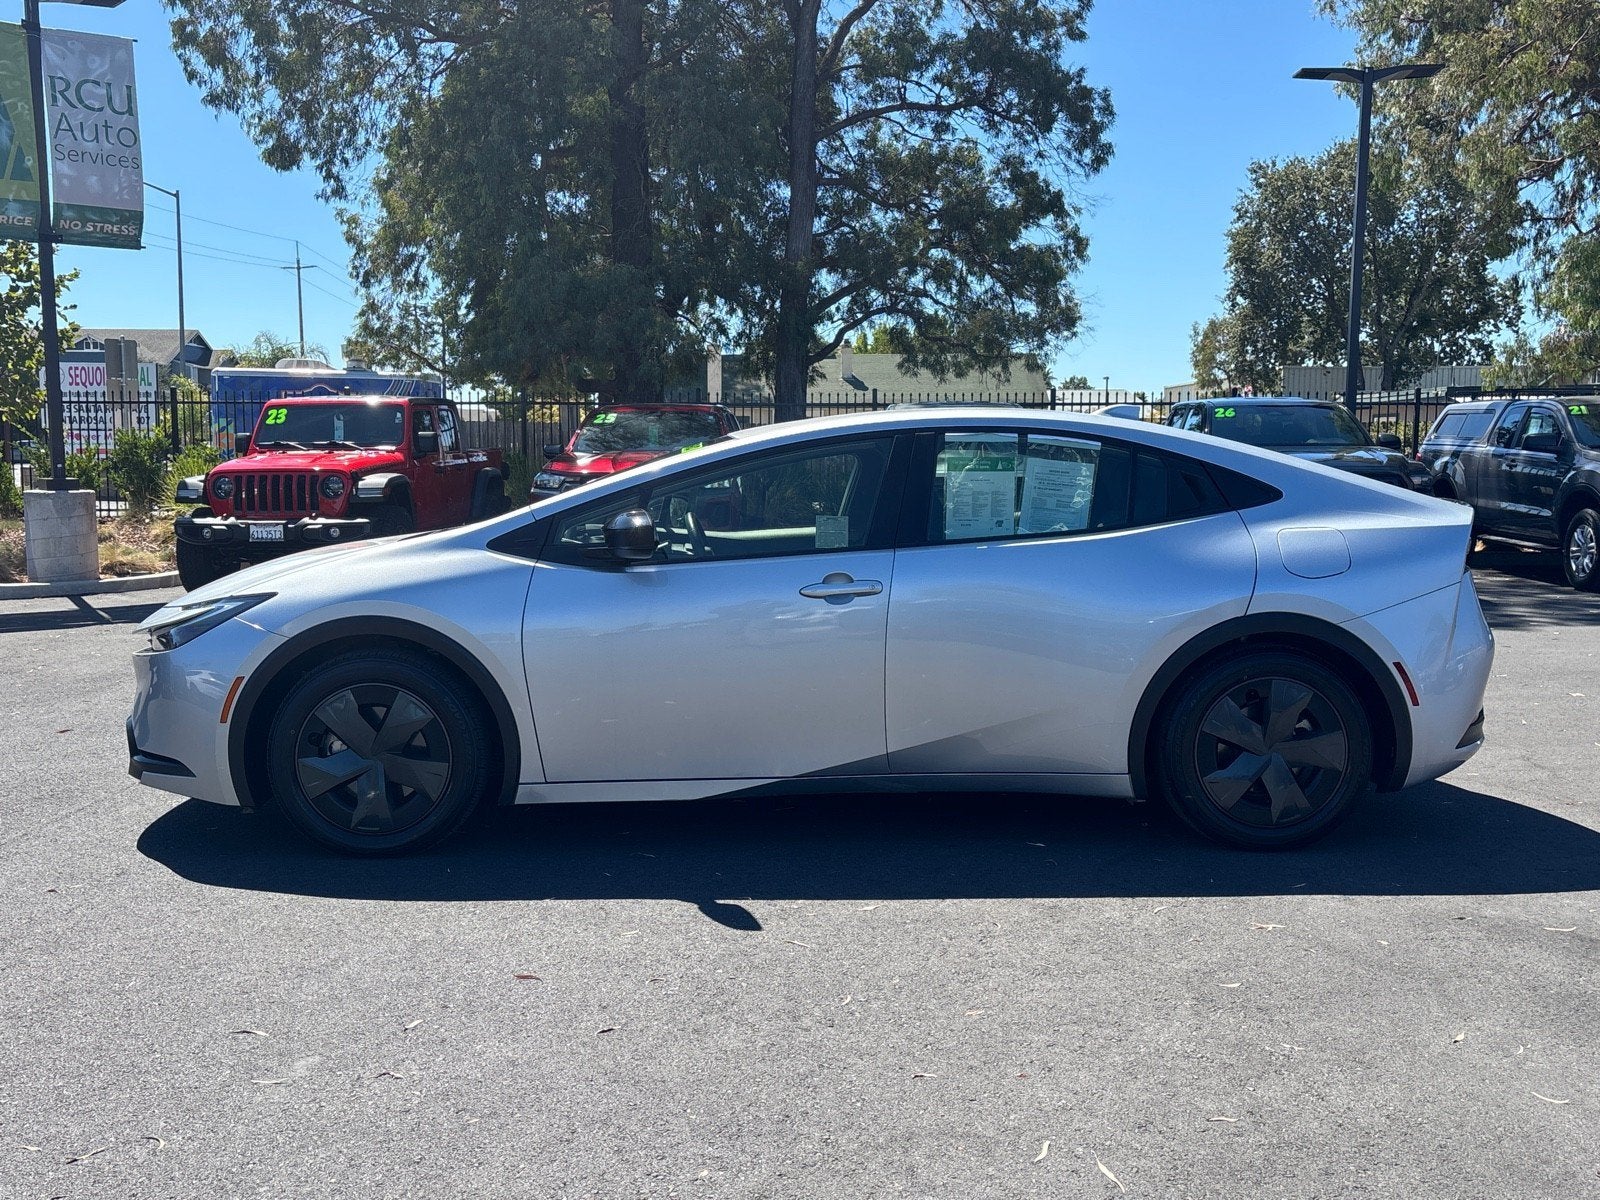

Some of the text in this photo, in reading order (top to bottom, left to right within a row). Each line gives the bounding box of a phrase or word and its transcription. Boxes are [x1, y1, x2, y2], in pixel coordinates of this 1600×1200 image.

[48, 75, 134, 117] RCU
[54, 112, 138, 148] Auto
[55, 144, 140, 169] Services
[0, 216, 32, 226] RICE
[60, 220, 136, 235] NO STRESS
[68, 366, 106, 388] SEQUOI
[265, 408, 288, 425] 23
[1214, 407, 1236, 418] 26
[1568, 405, 1589, 415] 21
[593, 413, 618, 424] 25
